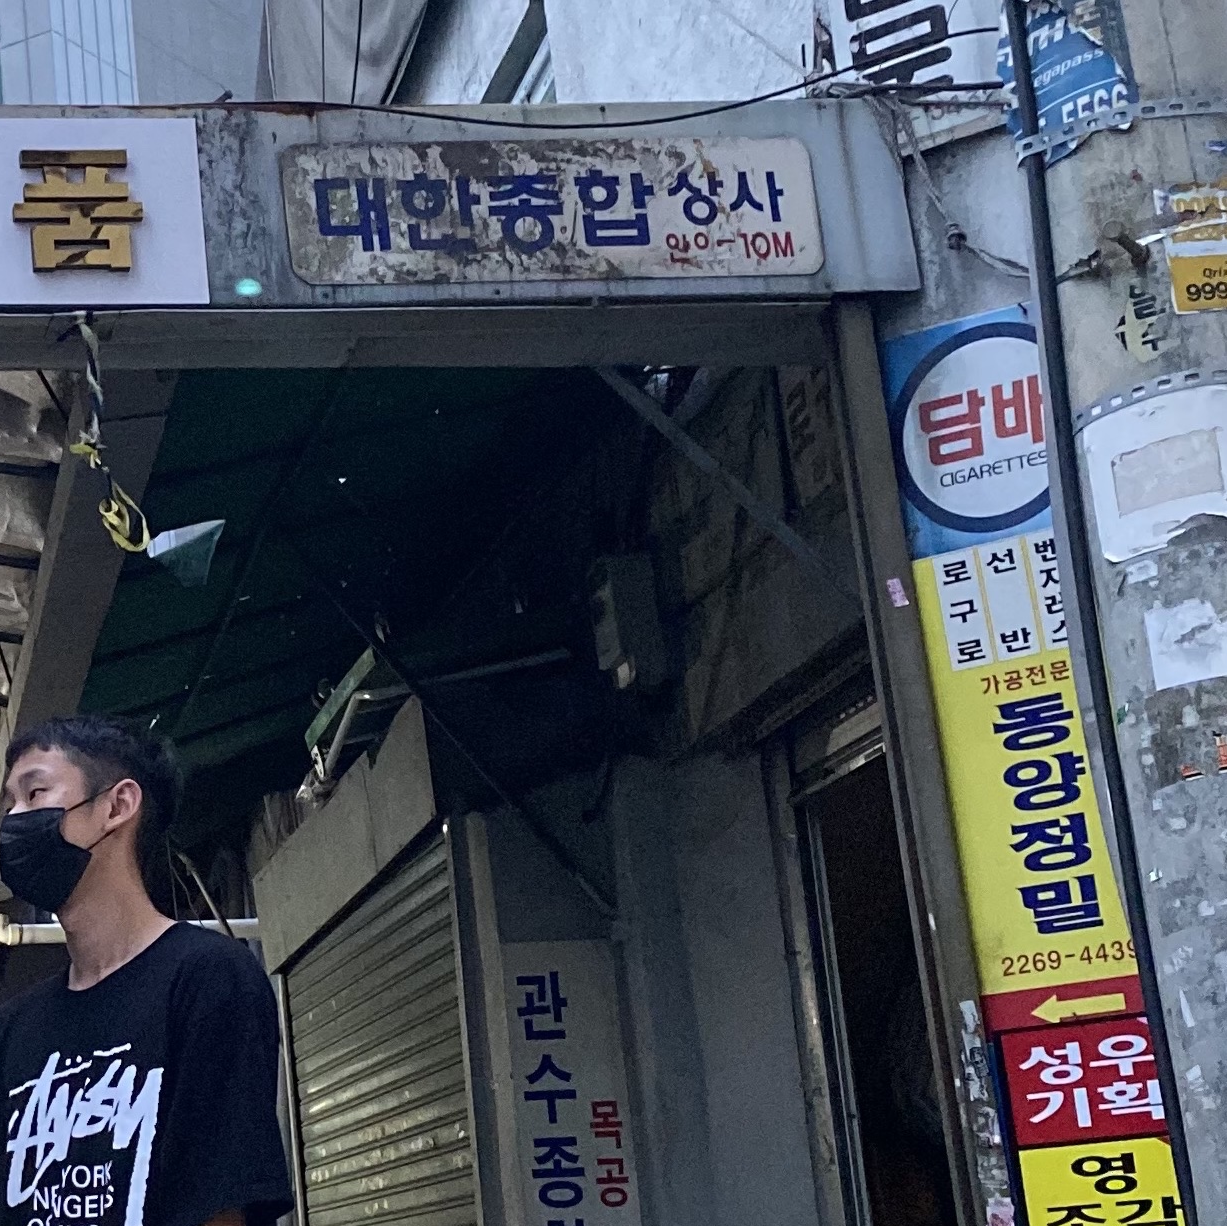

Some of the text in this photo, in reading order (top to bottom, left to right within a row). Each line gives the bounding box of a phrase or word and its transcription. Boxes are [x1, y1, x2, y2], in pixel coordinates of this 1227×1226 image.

[1034, 50, 1104, 88] egapass
[939, 451, 1048, 488] CIGARETTES
[981, 659, 1071, 695] 가공전문
[992, 692, 1104, 934] 동양정밀
[1018, 1033, 1155, 1086] 성우
[1026, 1078, 1166, 1129] 기획
[60, 1160, 113, 1189] YORK
[590, 1100, 629, 1208] 목공
[1070, 1152, 1138, 1195] 영
